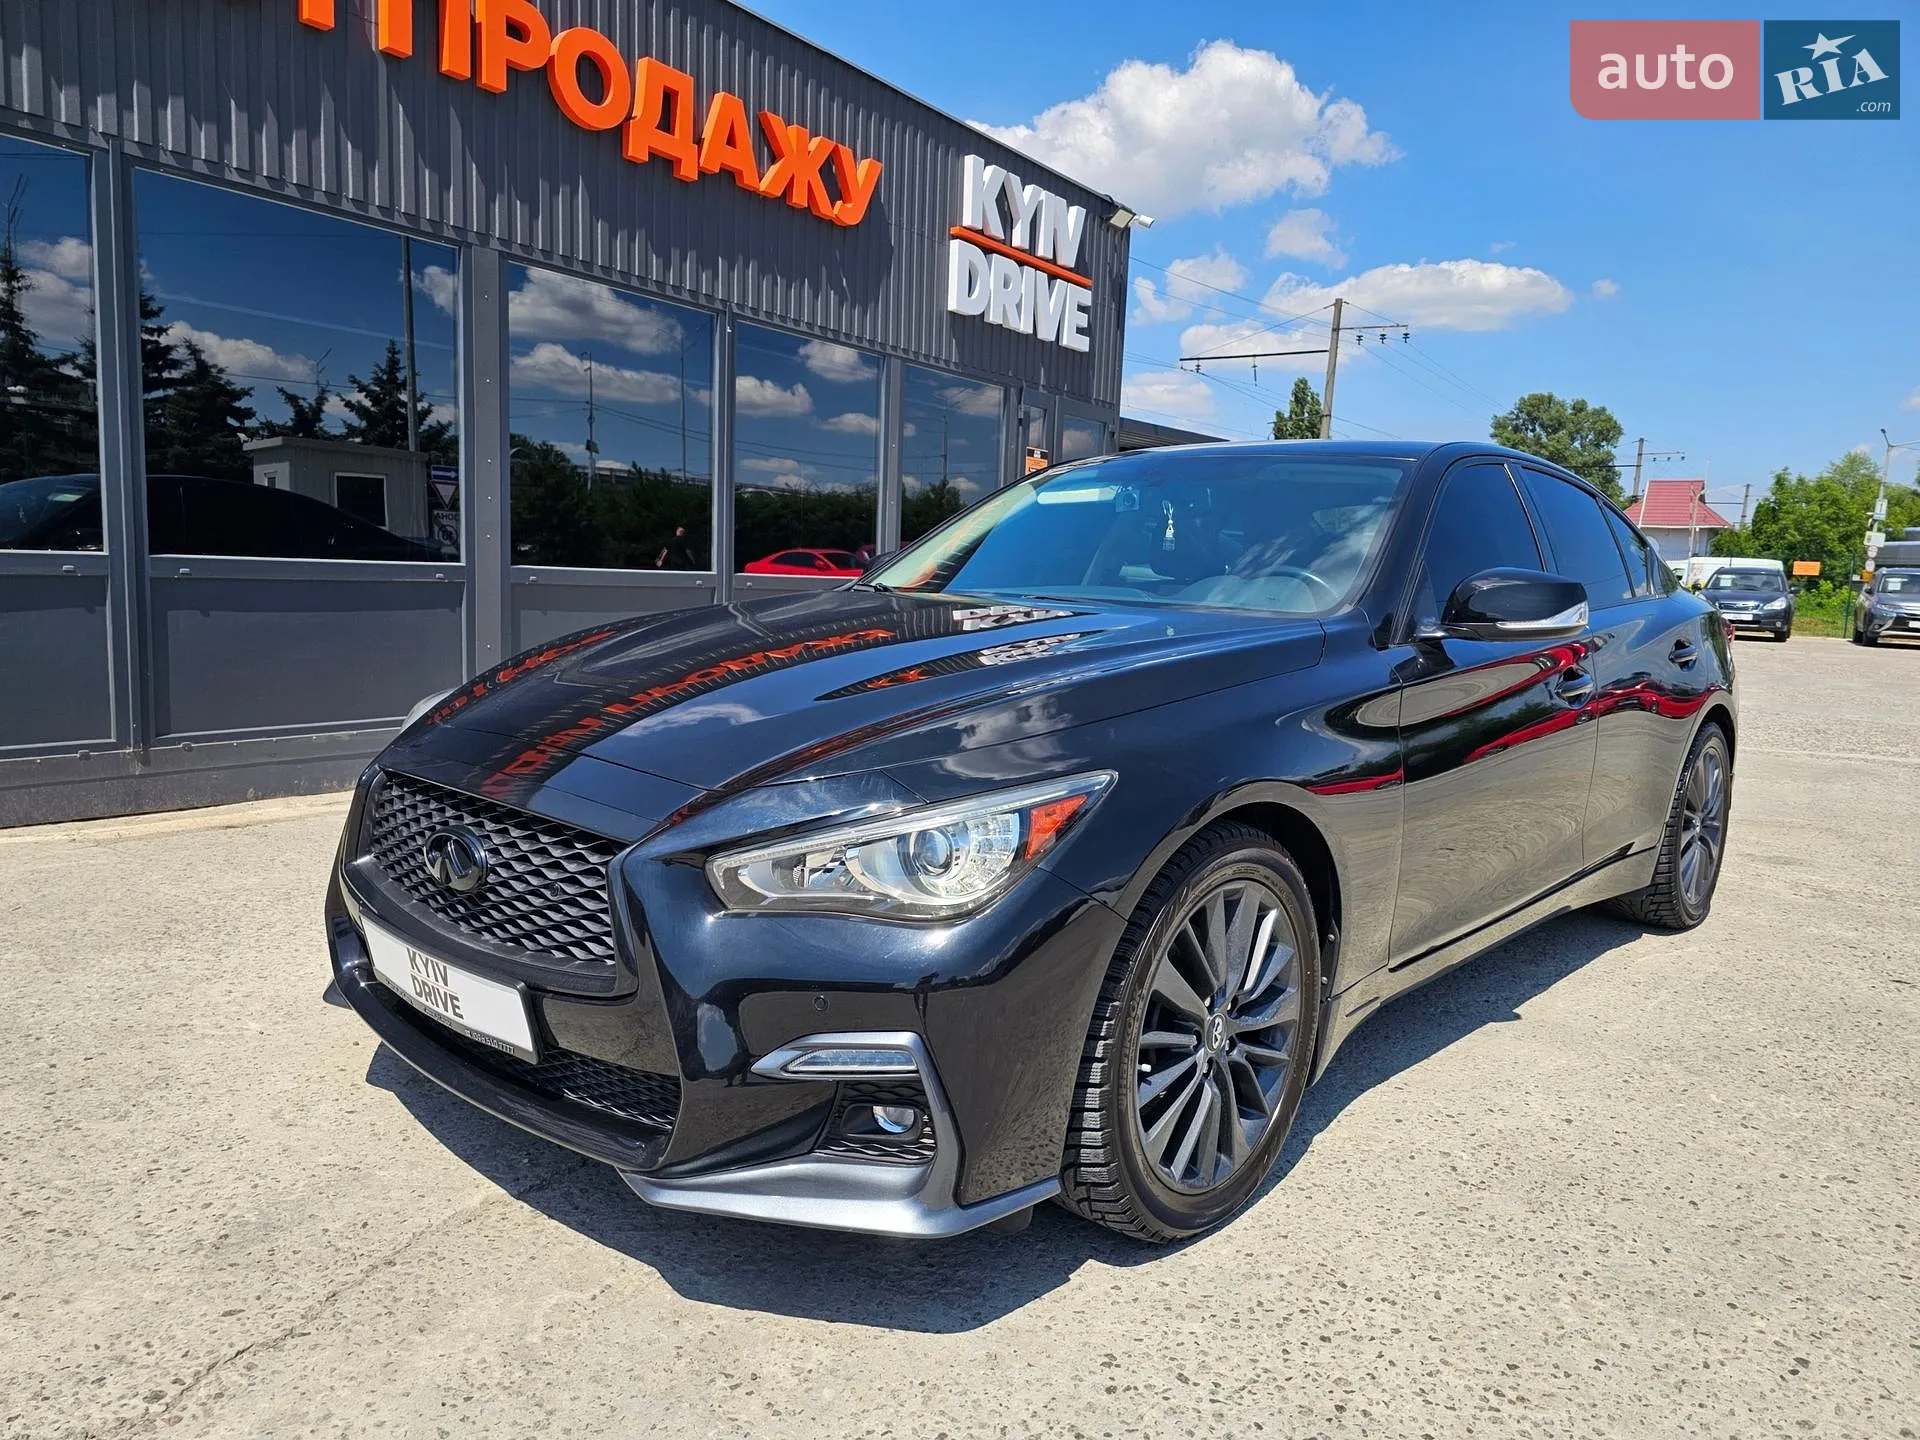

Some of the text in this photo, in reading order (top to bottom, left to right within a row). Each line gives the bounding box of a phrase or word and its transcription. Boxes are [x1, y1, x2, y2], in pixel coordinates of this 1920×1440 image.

[963, 154, 1087, 268] KYIV
[948, 238, 1092, 352] DRIVE
[406, 947, 449, 987] KYIV
[411, 973, 464, 1020] DRIVE
